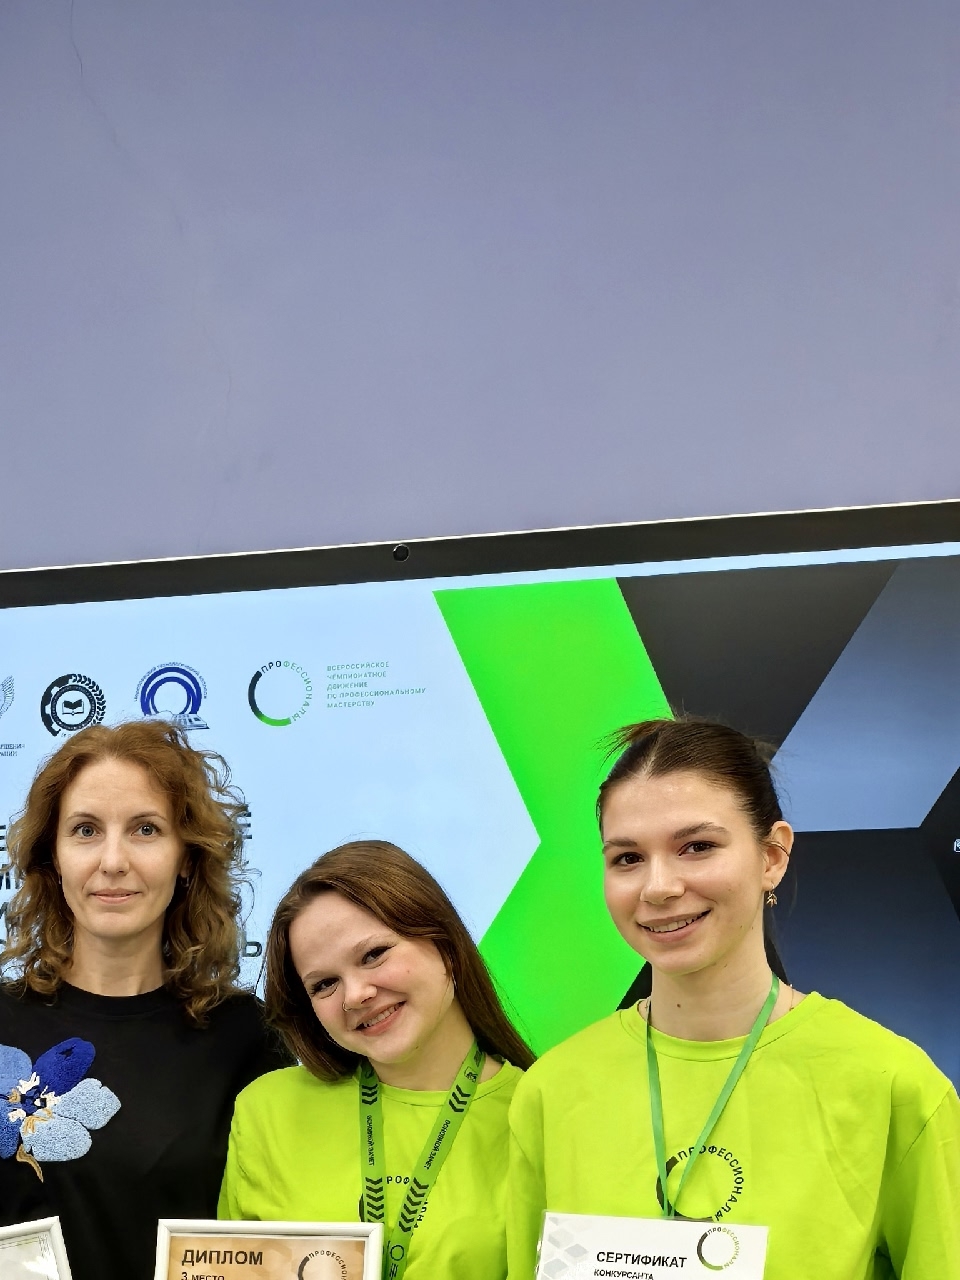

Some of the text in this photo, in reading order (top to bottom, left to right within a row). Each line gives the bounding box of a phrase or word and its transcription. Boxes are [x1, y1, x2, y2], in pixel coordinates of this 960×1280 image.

[181, 1249, 263, 1267] ДИПЛОМ
[596, 1251, 687, 1268] СЕРТИФИКАТ
[594, 1269, 654, 1280] КОНКУРСАНТА
